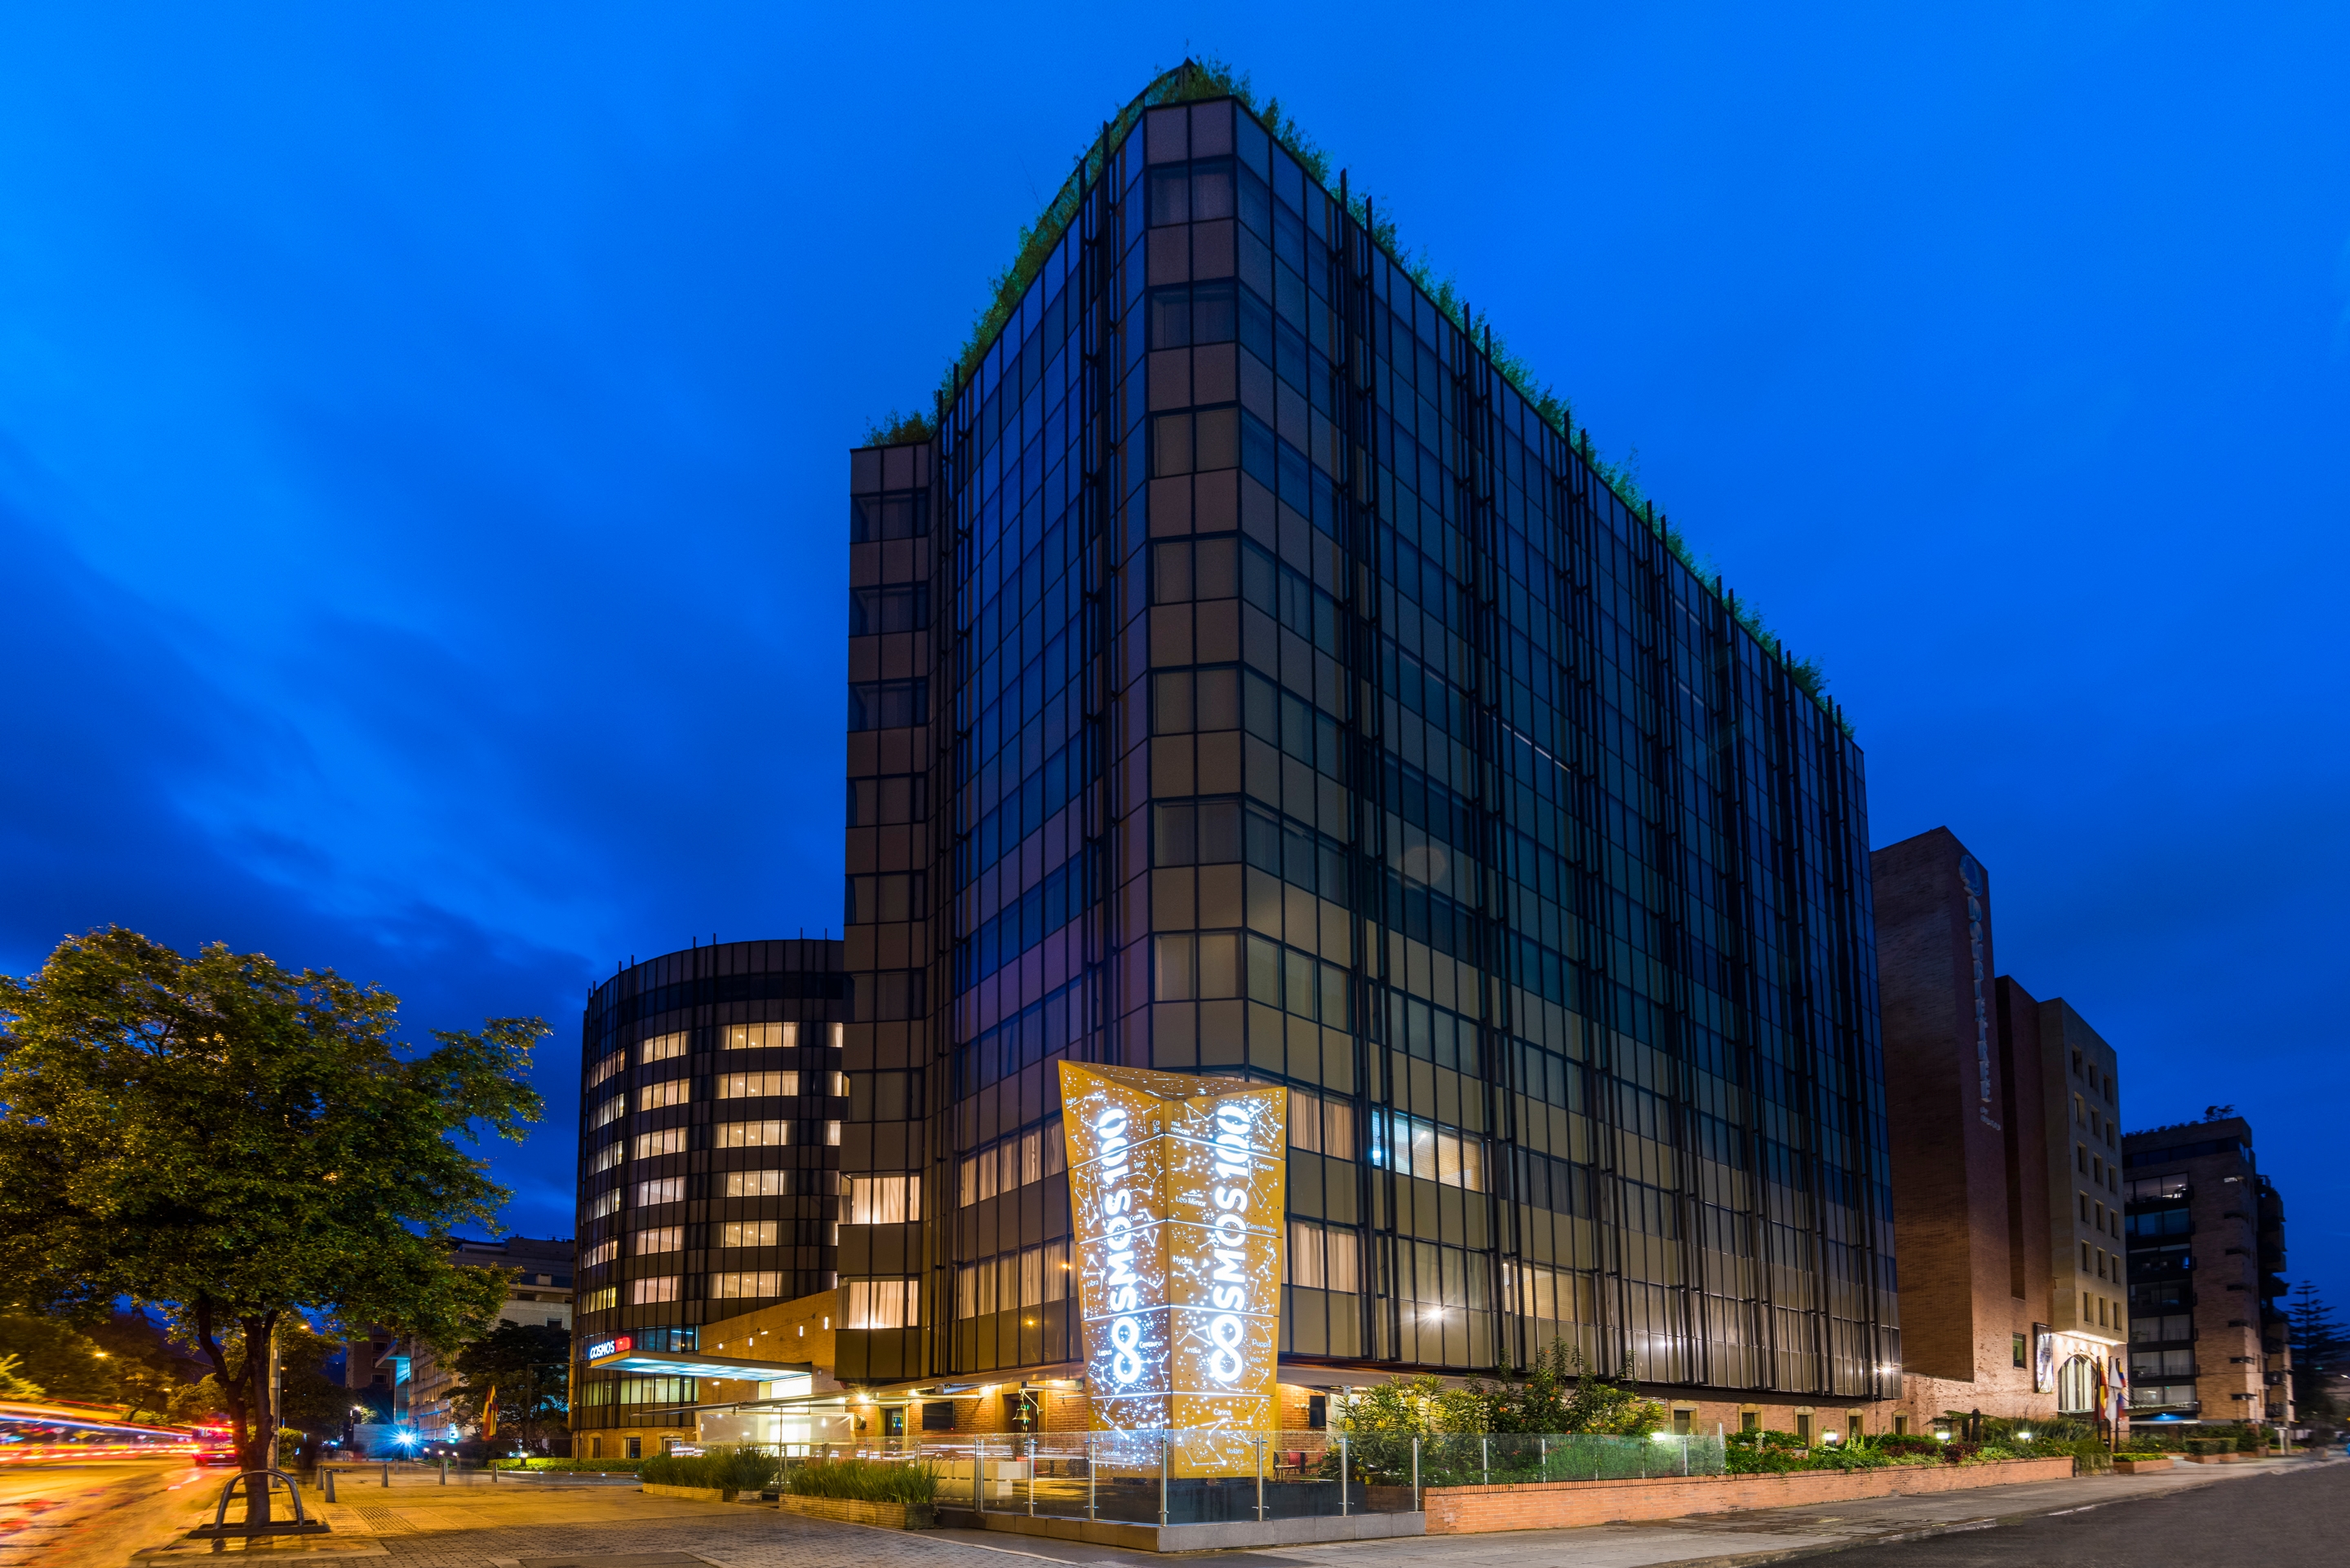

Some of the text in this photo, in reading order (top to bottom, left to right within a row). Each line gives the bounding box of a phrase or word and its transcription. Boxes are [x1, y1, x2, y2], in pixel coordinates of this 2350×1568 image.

[1097, 1109, 1129, 1185] 100
[1215, 1105, 1251, 1179] 100
[1251, 1142, 1270, 1153] Gemini
[1133, 1160, 1146, 1169] Virgo
[1255, 1161, 1275, 1172] Cancer
[1175, 1195, 1207, 1207] Leo Minor
[1246, 1221, 1277, 1234] Canis Major
[1173, 1255, 1193, 1265] Hydra
[1087, 1279, 1099, 1287] Libra
[1252, 1338, 1271, 1348] Puppis
[590, 1340, 615, 1359] COSMOS
[1213, 1408, 1231, 1416] Carina
